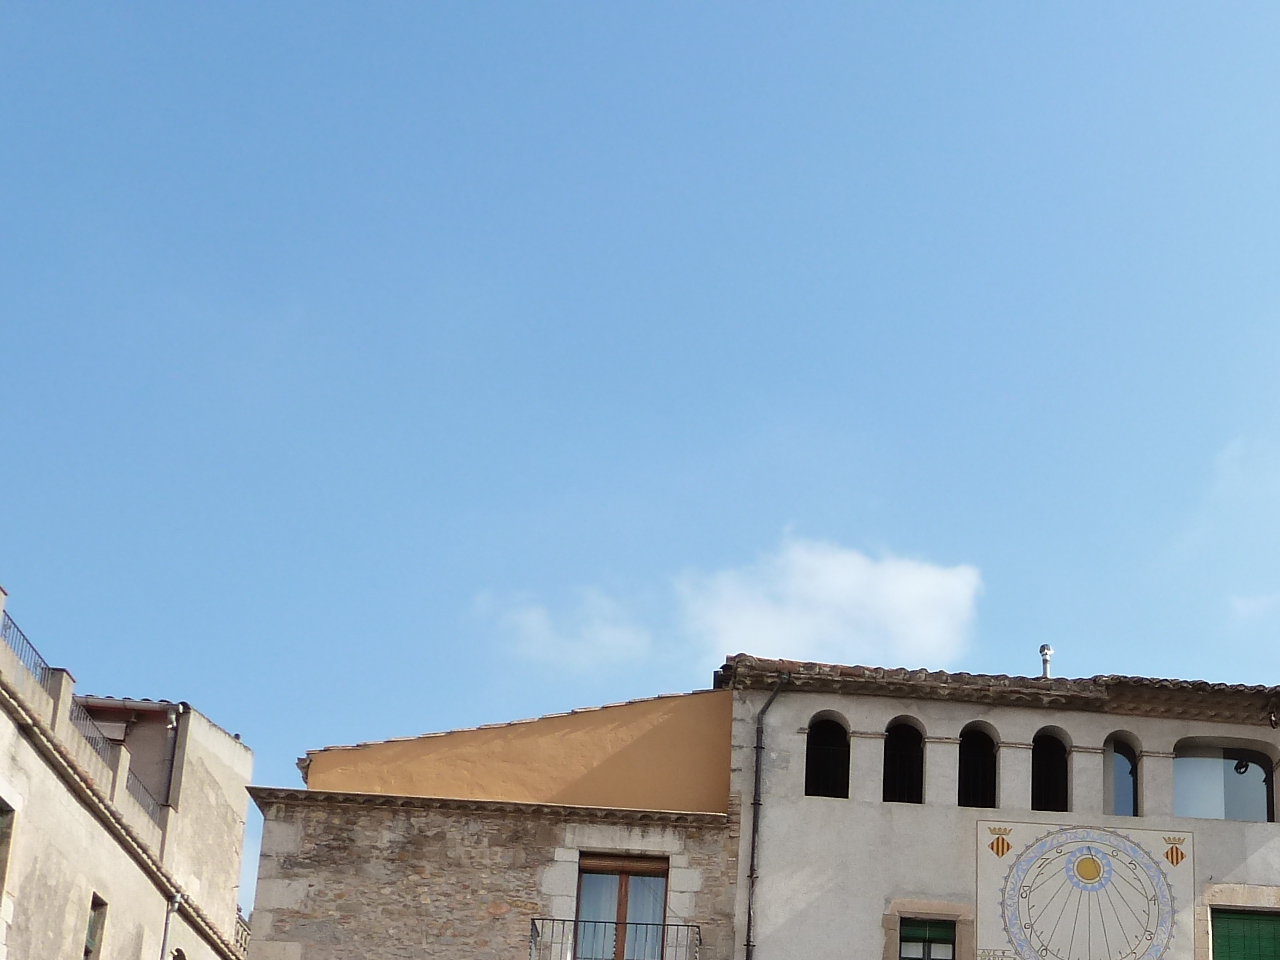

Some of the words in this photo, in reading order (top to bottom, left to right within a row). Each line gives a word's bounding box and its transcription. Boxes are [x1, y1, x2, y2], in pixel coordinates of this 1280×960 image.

[1037, 857, 1050, 869] 7
[1128, 859, 1138, 871] 5
[1020, 885, 1031, 899] 8
[1148, 894, 1158, 906] 4
[1145, 930, 1154, 941] 3
